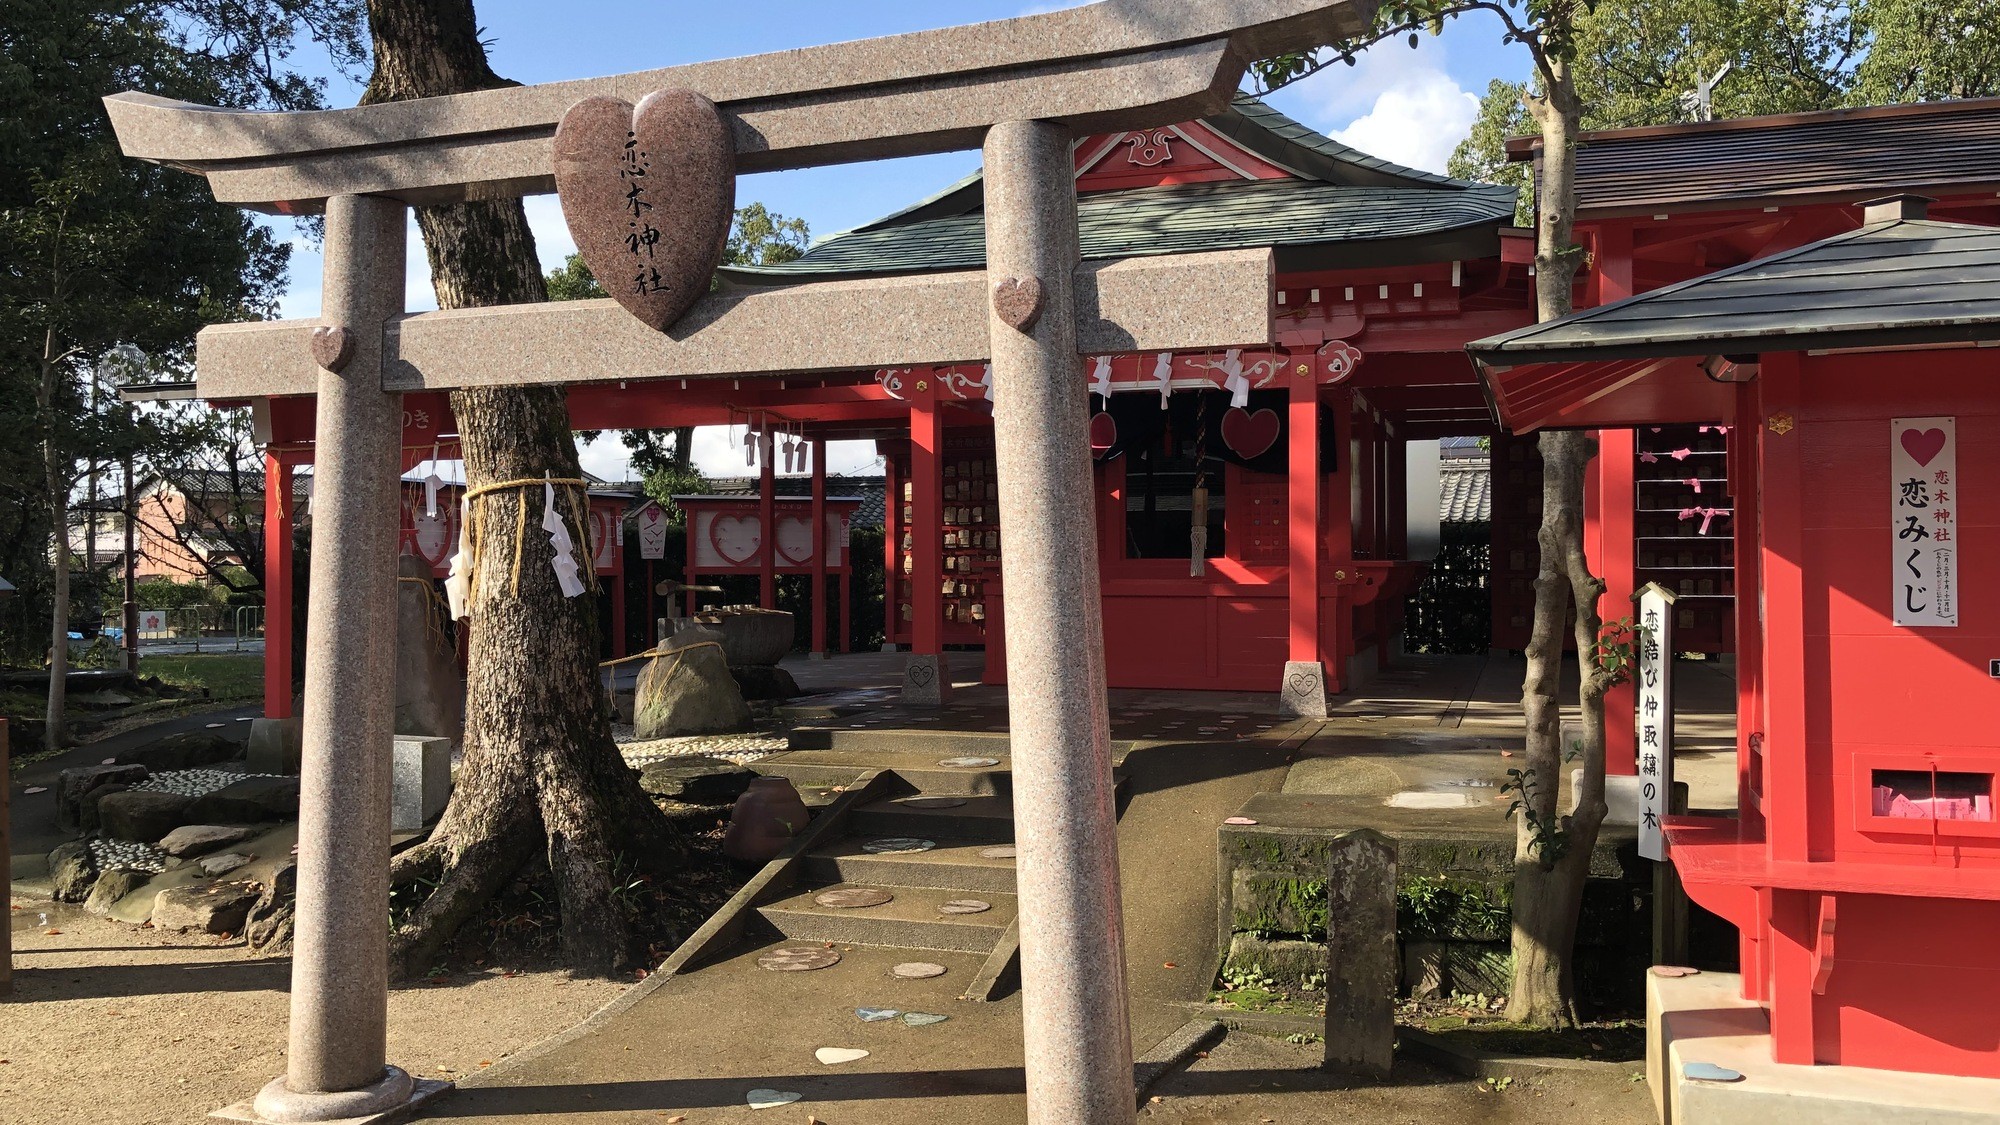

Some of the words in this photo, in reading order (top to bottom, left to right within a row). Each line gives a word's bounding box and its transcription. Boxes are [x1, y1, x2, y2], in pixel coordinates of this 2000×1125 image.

[620, 131, 670, 296] 恋木神社
[1899, 477, 1930, 613] 恋みくじ
[1933, 470, 1951, 542] 恋木神社
